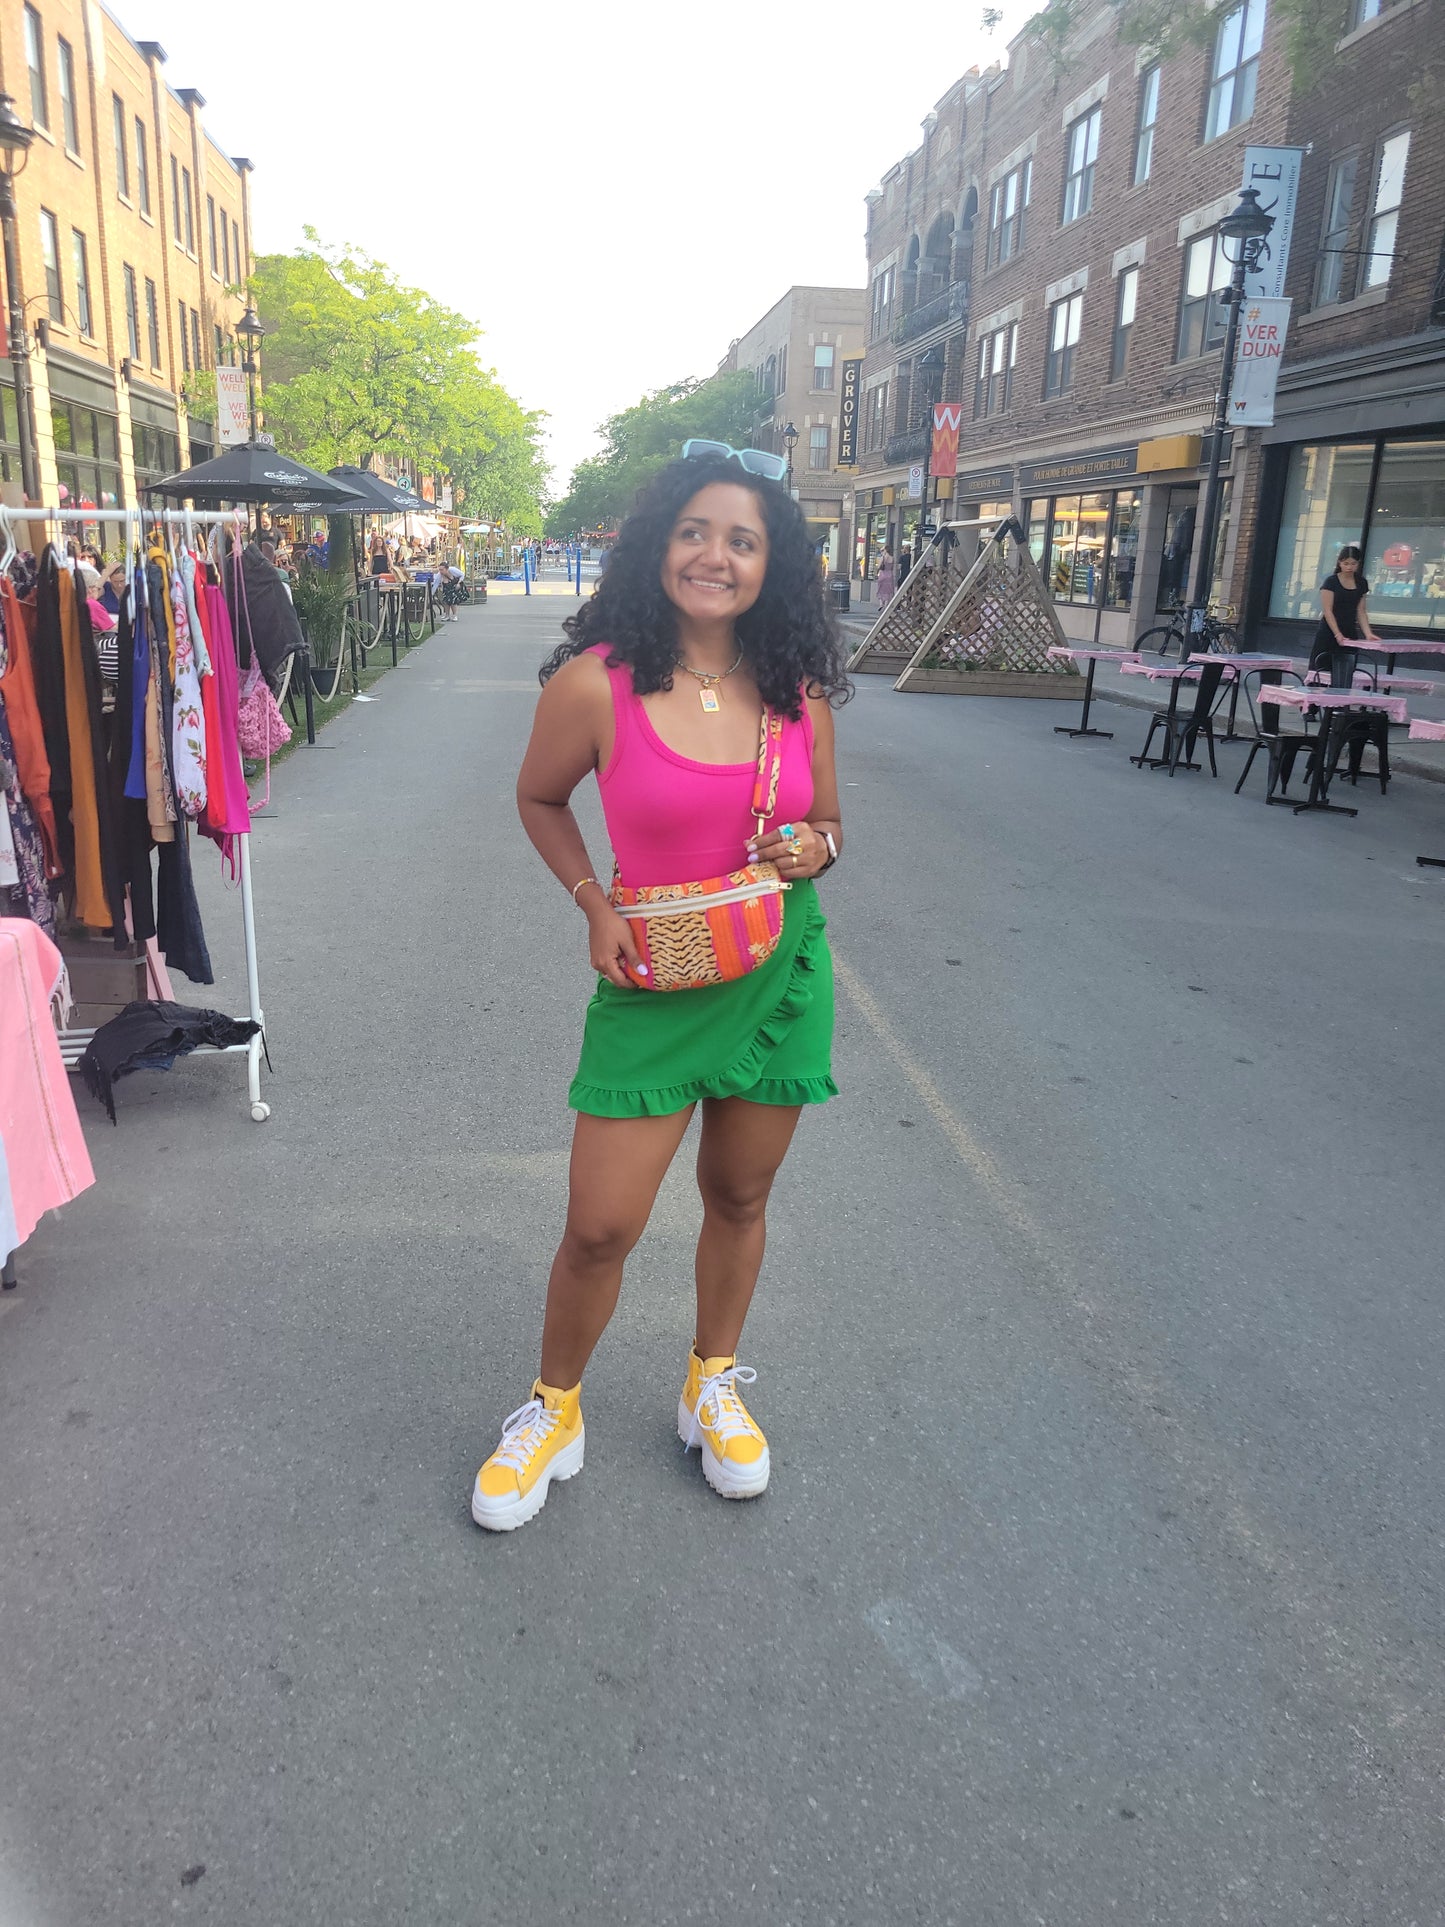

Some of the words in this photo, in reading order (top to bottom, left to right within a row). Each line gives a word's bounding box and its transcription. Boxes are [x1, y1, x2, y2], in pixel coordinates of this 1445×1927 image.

[1246, 324, 1278, 340] VER
[1242, 342, 1281, 358] DUN
[219, 373, 245, 384] WELL
[842, 369, 856, 457] GROVER
